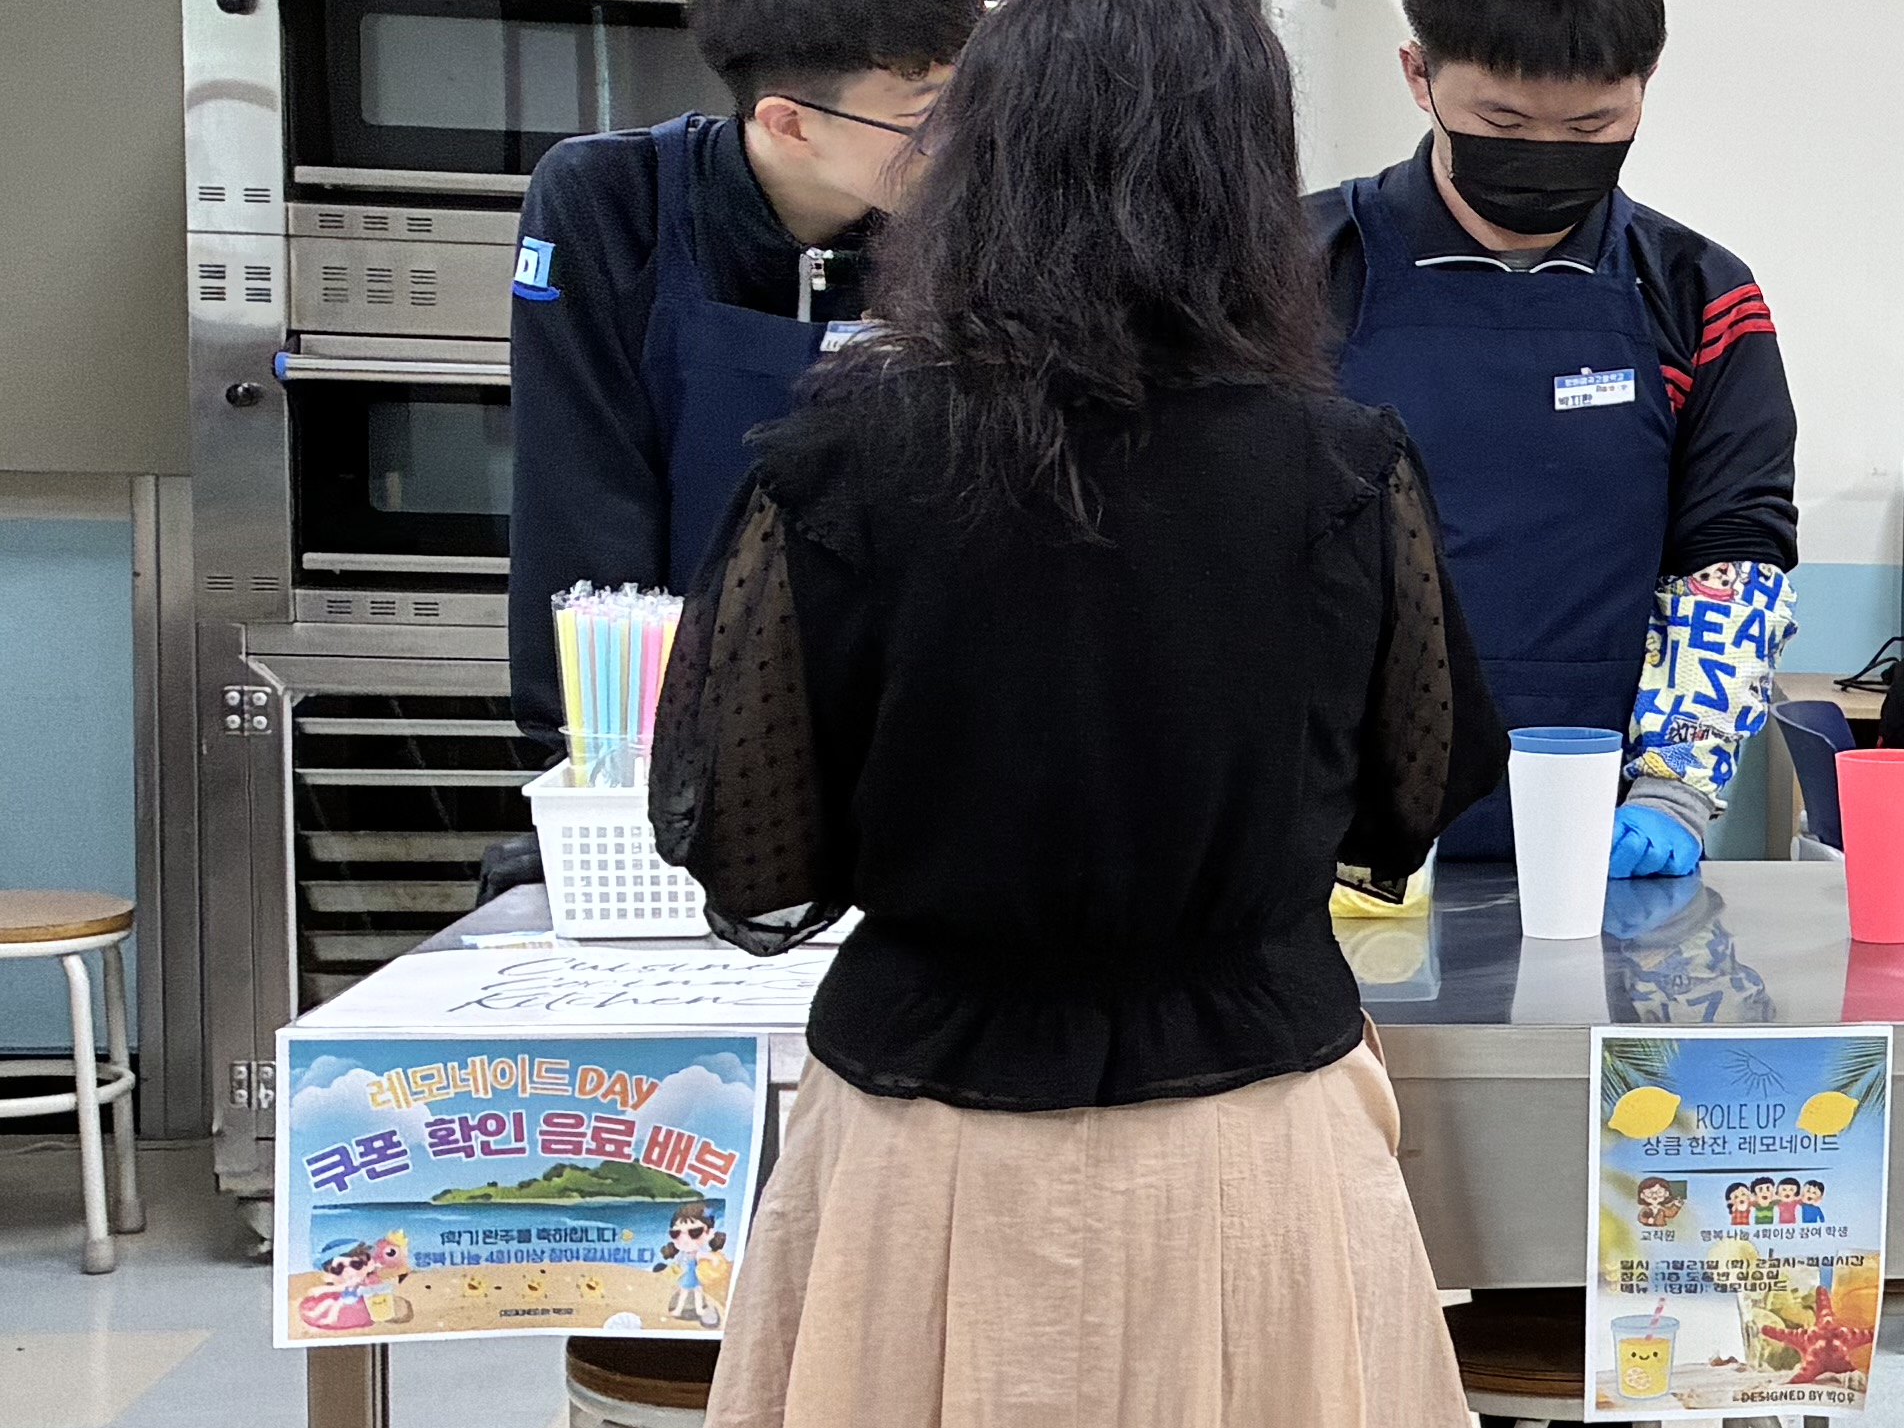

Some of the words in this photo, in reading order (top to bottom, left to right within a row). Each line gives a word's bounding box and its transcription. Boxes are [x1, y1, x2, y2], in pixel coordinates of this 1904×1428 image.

[1696, 1103, 1749, 1130] ROLE
[1756, 1103, 1786, 1129] UP
[303, 1128, 411, 1193] 쿠폰
[424, 1110, 528, 1160] 확인
[538, 1111, 638, 1161] 음료
[640, 1124, 740, 1188] 배부
[1642, 1136, 1683, 1156] 상큼
[1738, 1134, 1840, 1154] 레모네이드
[1640, 1230, 1675, 1242] 교직원
[1826, 1225, 1849, 1238] 학생
[1741, 1390, 1805, 1402] DESIGNED
[1809, 1390, 1823, 1401] BY
